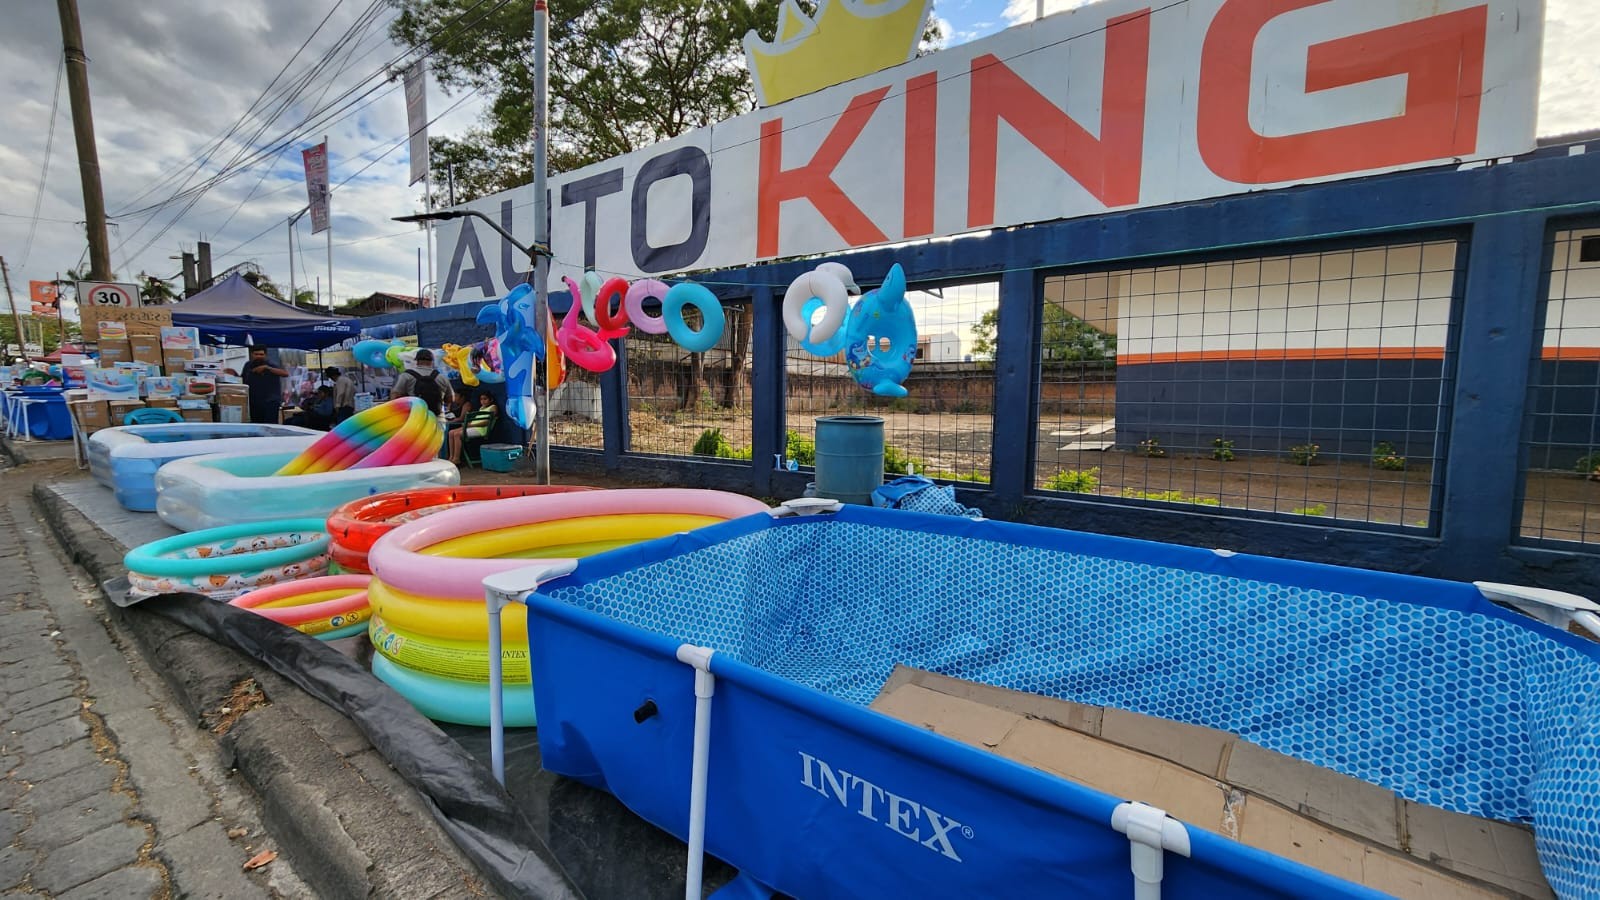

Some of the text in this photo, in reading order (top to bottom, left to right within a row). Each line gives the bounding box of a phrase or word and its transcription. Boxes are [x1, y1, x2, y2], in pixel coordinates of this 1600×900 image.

[440, 0, 1488, 304] AUTO KING
[98, 291, 121, 304] 30
[502, 650, 527, 659] INTEX
